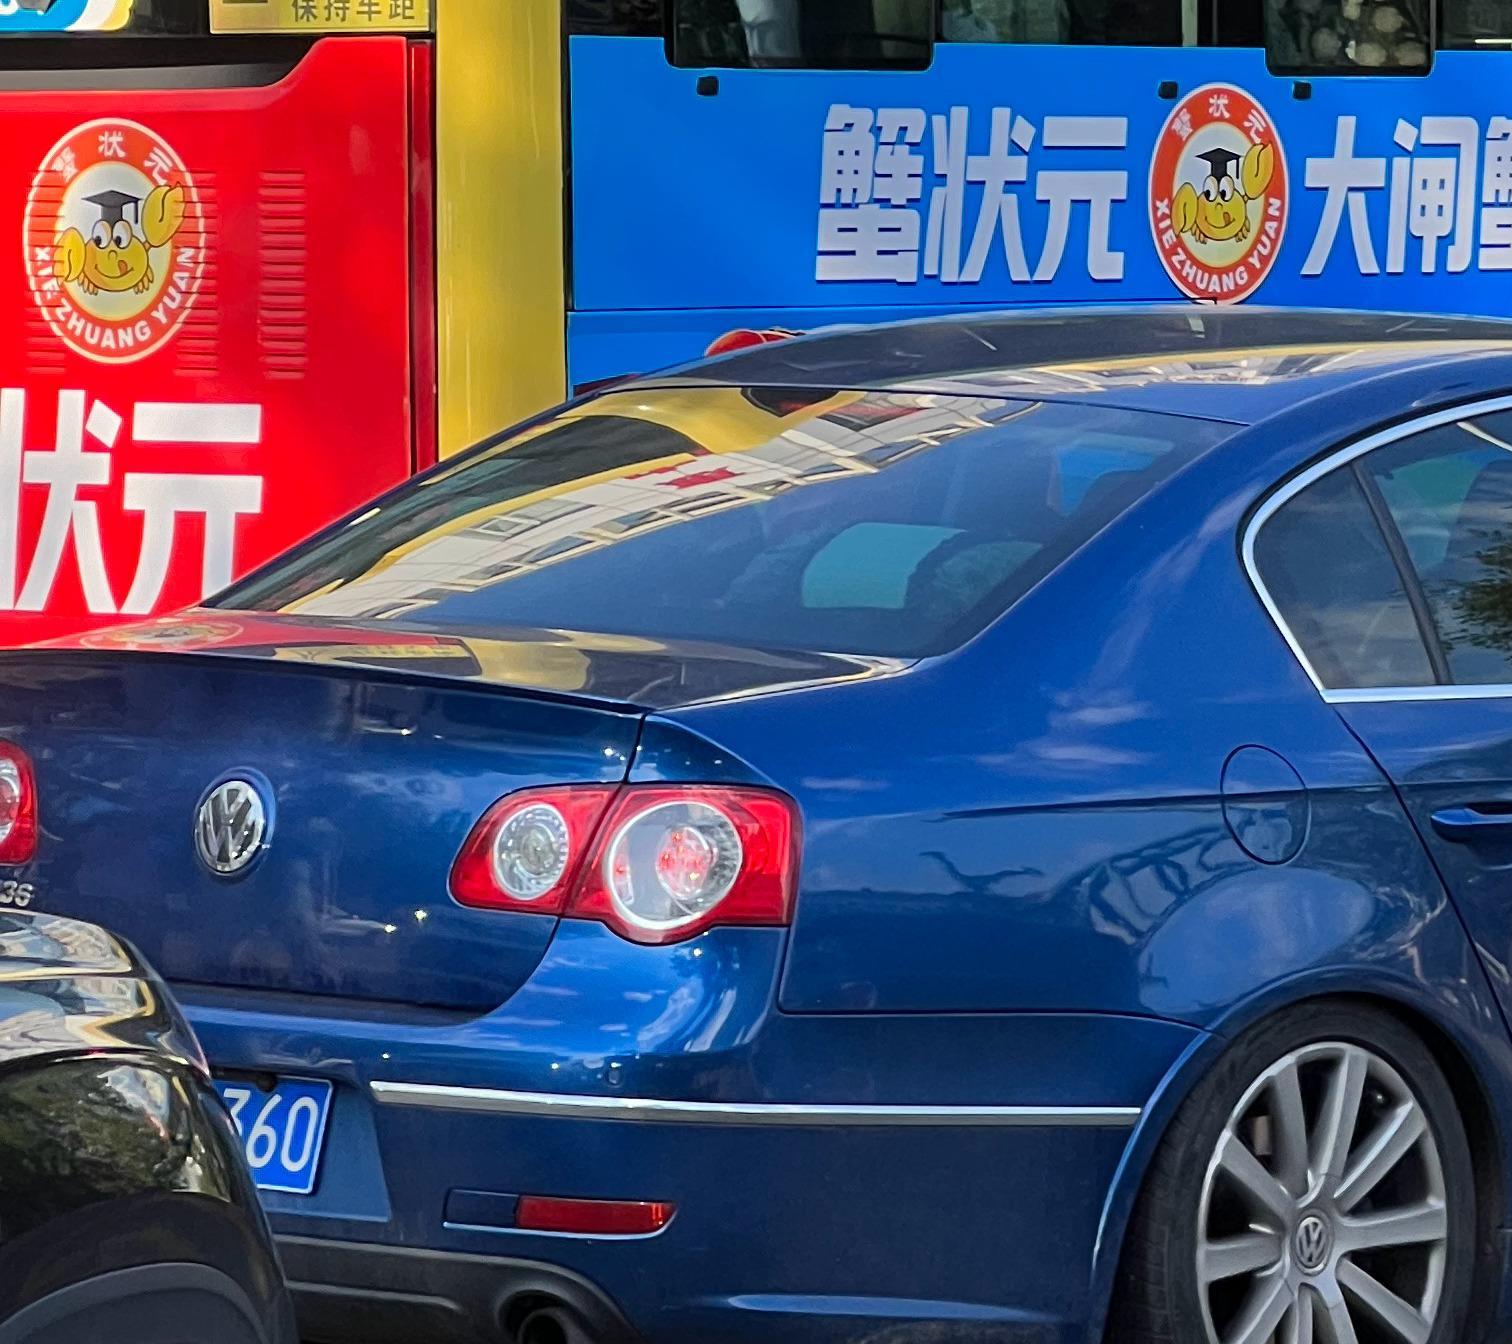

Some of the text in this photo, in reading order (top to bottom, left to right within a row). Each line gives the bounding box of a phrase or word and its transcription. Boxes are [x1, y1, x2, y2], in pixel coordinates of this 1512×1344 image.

[51, 131, 174, 186] 蟹状元
[1171, 93, 1267, 144] 蟹状元
[815, 103, 1129, 284] 蟹状元
[1155, 197, 1282, 294] XIE ZHUANG YUAN
[54, 297, 152, 349] ZHUANG
[150, 247, 196, 326] YUAN
[0, 388, 262, 614] 状元
